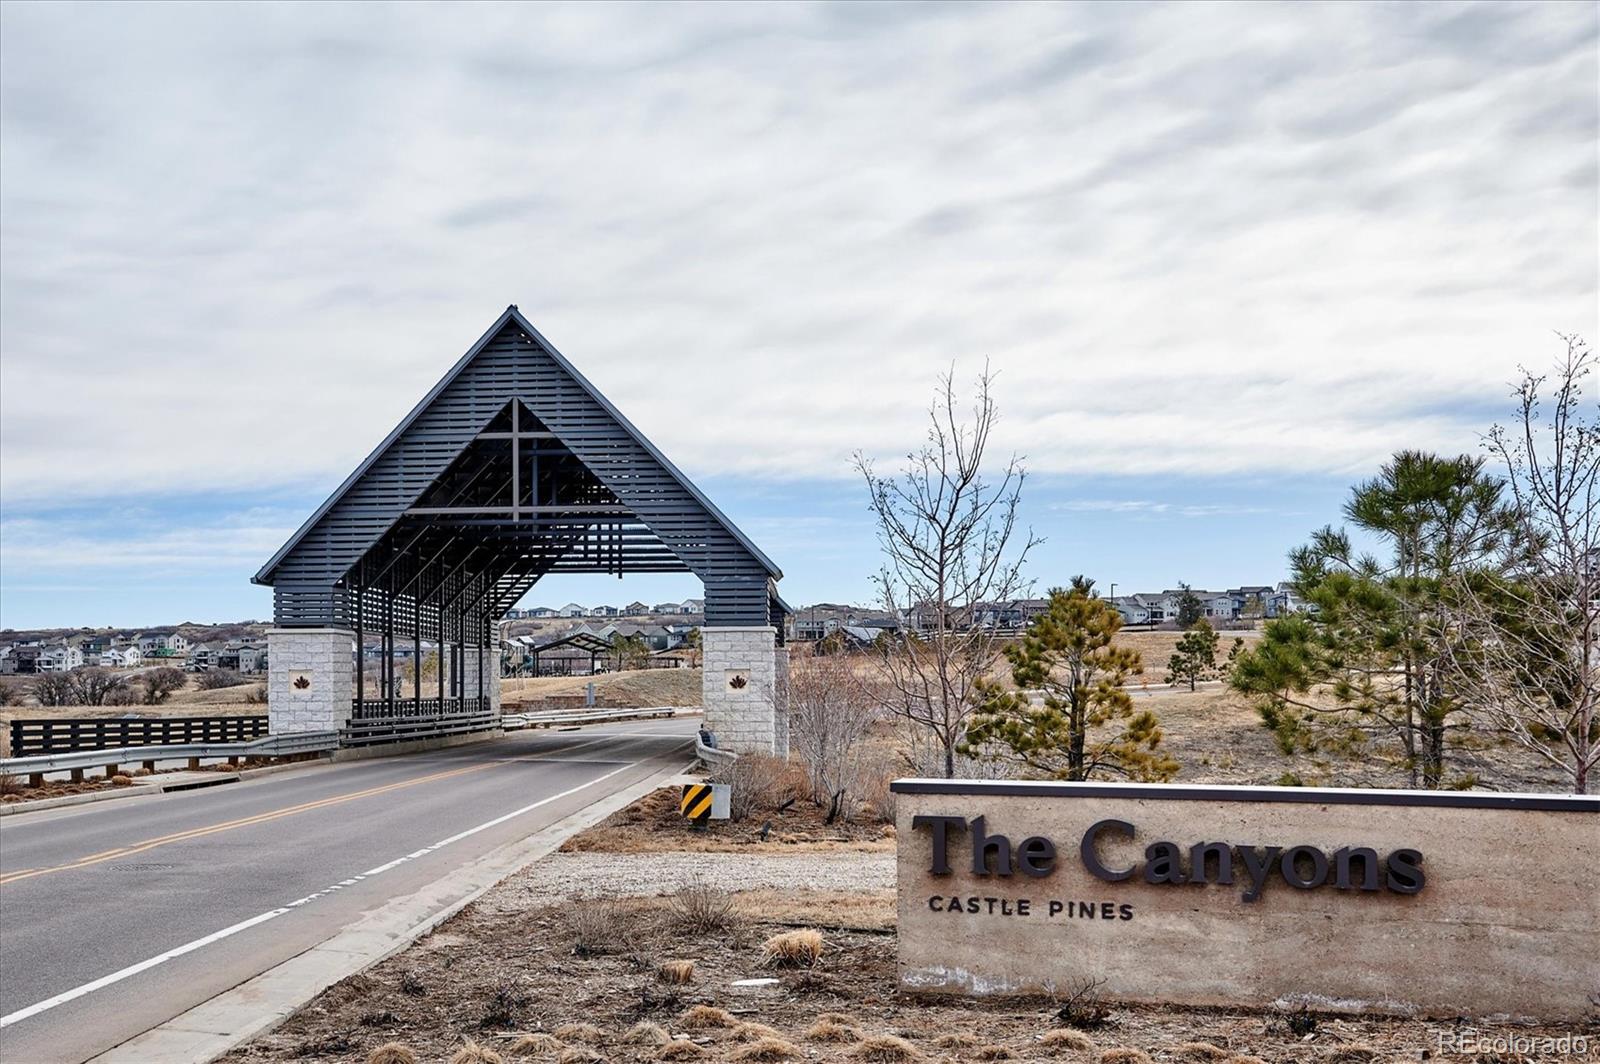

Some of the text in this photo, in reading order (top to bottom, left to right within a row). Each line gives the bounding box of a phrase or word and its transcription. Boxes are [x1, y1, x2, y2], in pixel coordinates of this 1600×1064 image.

[912, 814, 1426, 902] The Canyons
[928, 895, 1134, 920] CASTLE PINES
